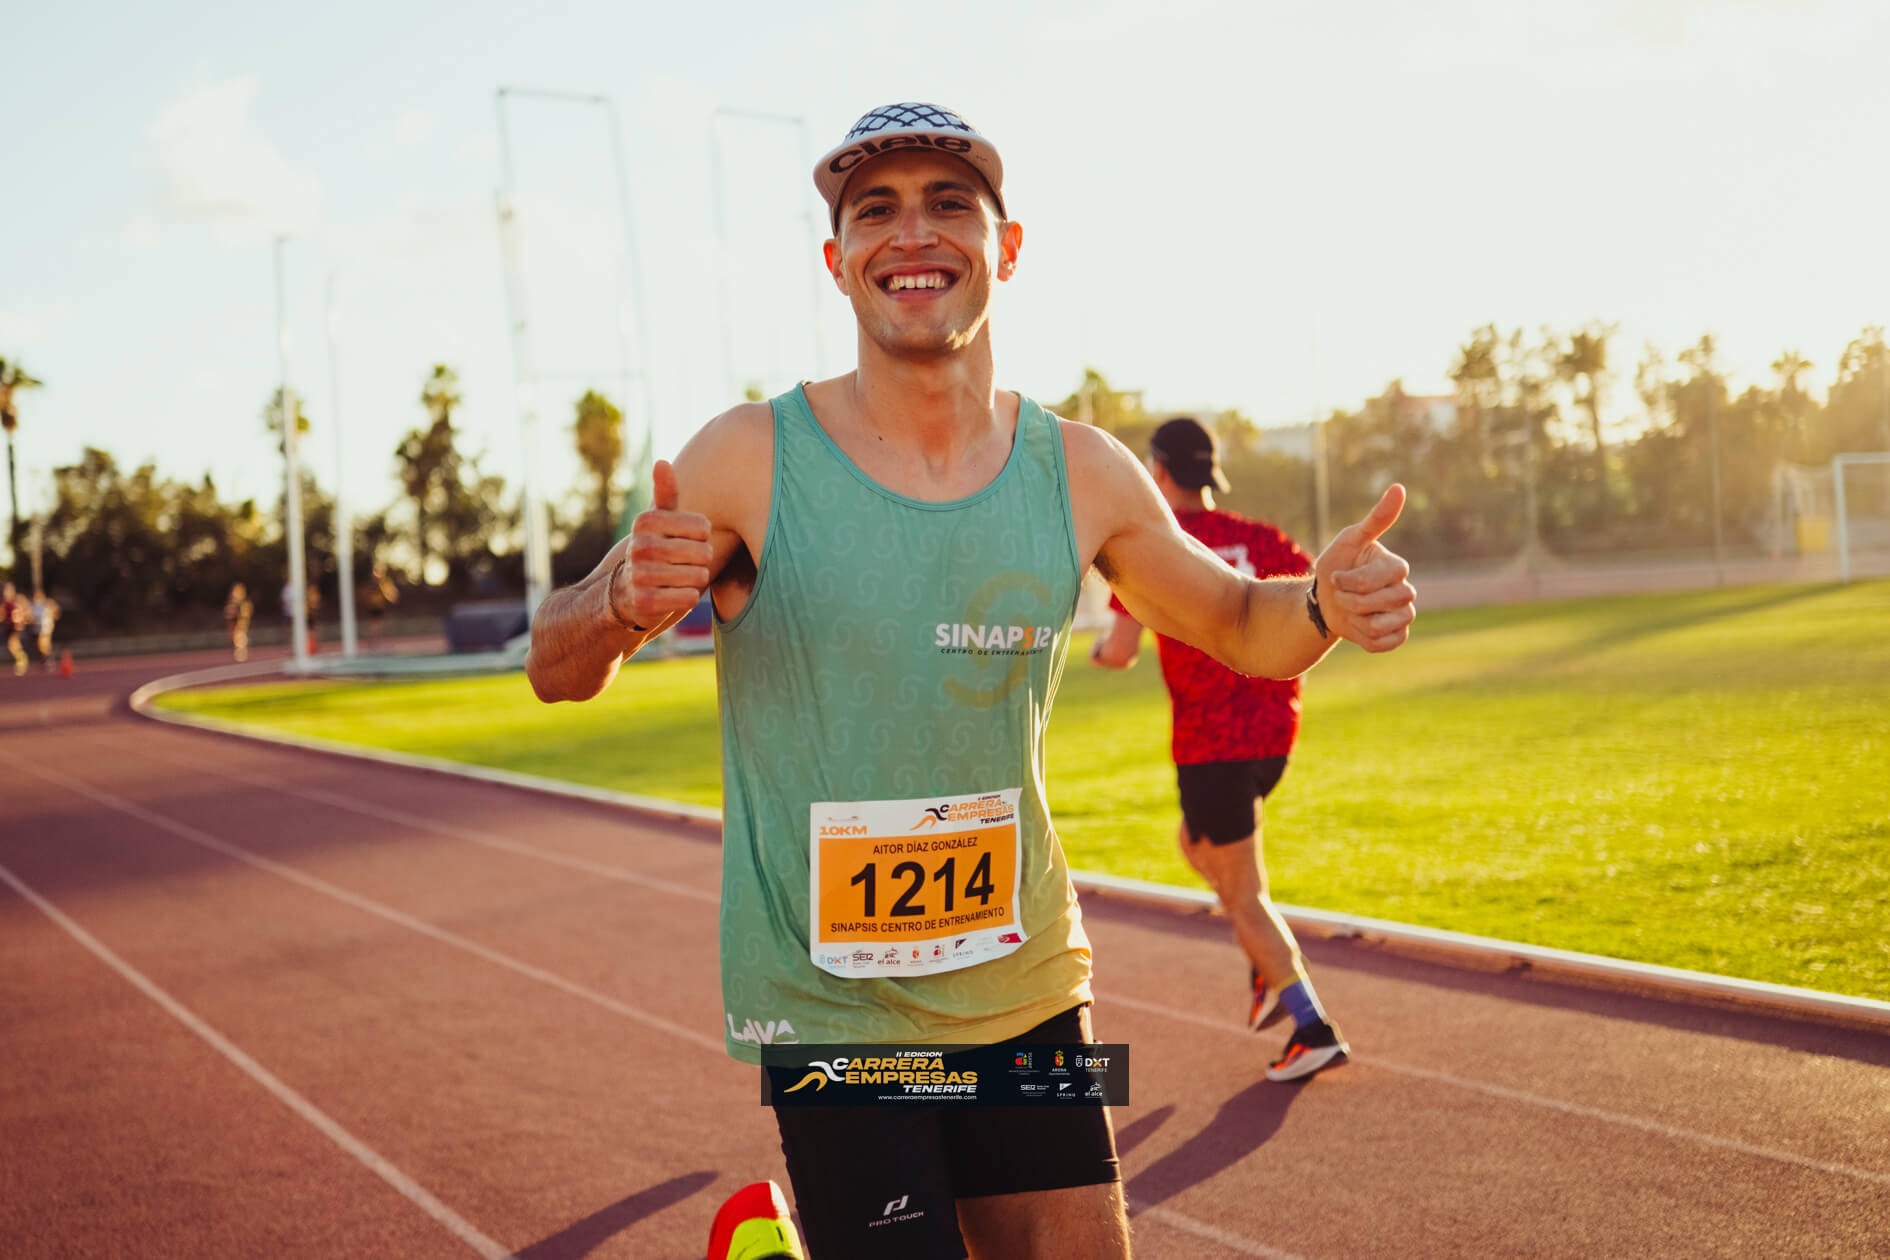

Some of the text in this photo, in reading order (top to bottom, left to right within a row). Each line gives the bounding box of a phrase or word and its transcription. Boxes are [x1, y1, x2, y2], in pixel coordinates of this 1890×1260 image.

[940, 799, 1004, 813] CARRERA
[947, 804, 1014, 822] EMPRESAS
[980, 813, 1015, 824] TENERIFE
[819, 825, 868, 836] 10KM
[873, 837, 978, 855] AITOR DÍAZ GONZÁLEZ
[851, 851, 995, 917] 1214
[831, 906, 1005, 933] SINAPSIS CENTRO DE ENTRENAMIENTO
[727, 1013, 800, 1044] LAVA
[869, 1211, 924, 1227] PRO TOUCH
